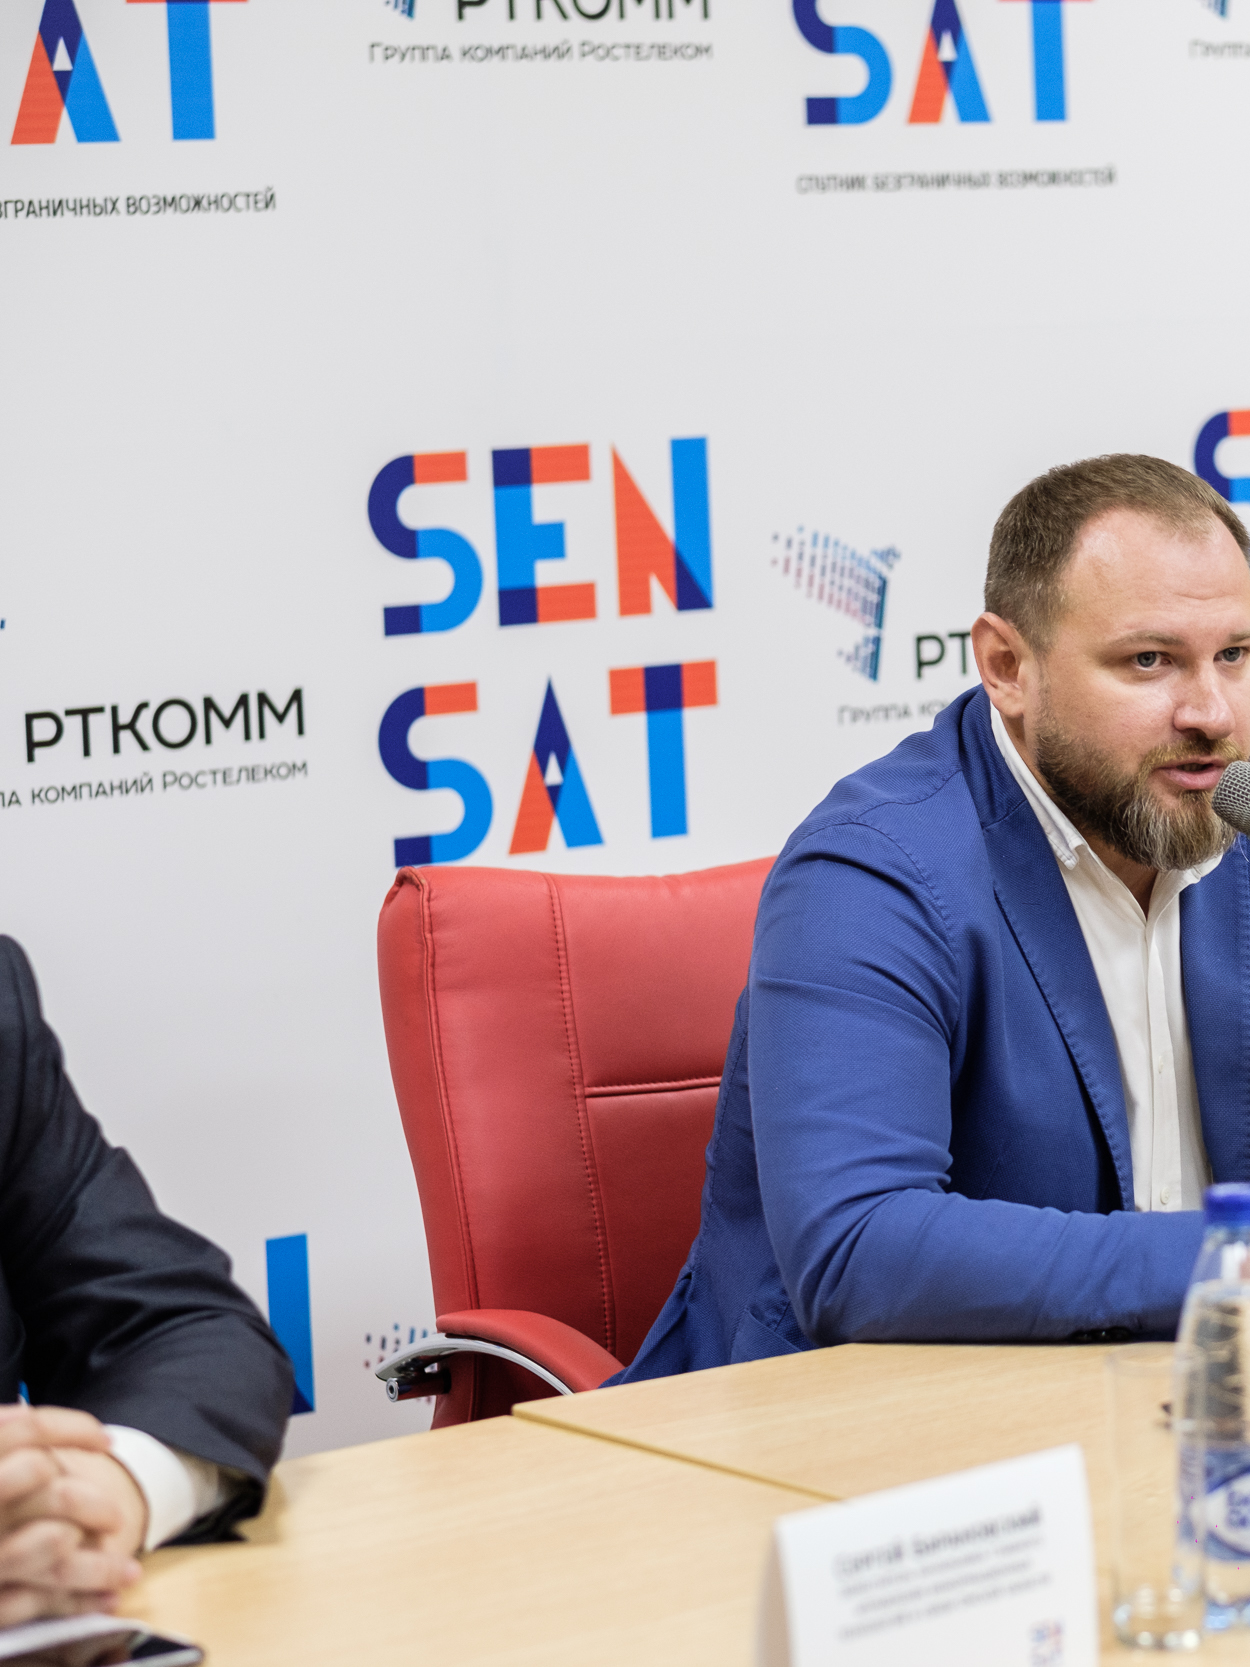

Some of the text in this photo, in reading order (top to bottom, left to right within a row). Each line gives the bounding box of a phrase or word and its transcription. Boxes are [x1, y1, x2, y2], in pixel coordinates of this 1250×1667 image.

[0, 186, 276, 220] ГРАНИЧНЫХ ВОЗМОЖНОСТЕЙ
[367, 436, 714, 637] SEN
[25, 687, 304, 763] РТКОММ
[378, 660, 718, 868] SAT
